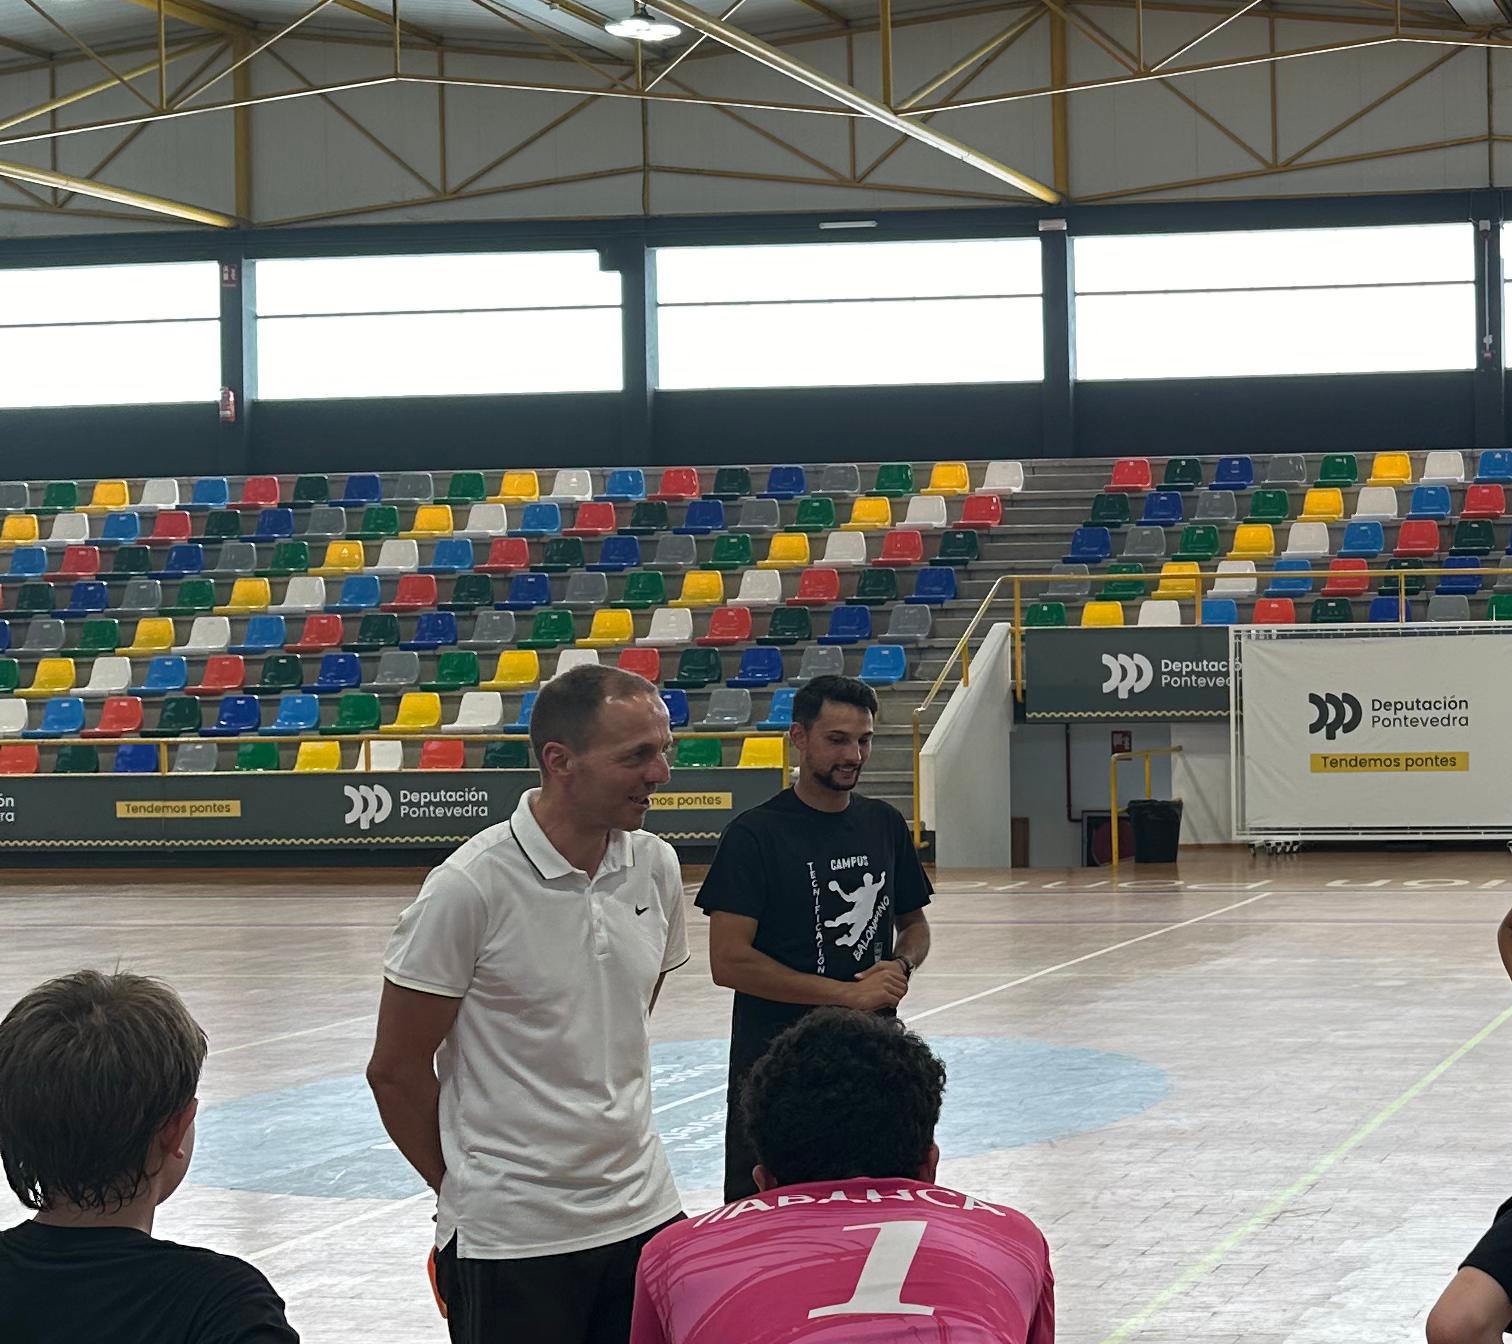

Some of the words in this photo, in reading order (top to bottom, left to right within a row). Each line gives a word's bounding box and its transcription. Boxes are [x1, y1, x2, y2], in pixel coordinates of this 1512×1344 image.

[1161, 657, 1243, 676] Deputacó
[1371, 695, 1469, 715] Deputación
[1371, 714, 1469, 728] Pontevedra
[1321, 756, 1400, 768] Tendemos
[1405, 756, 1457, 771] pontes
[400, 787, 488, 806] Deputación
[678, 795, 722, 808] pontes
[125, 803, 187, 814] Tendemos
[189, 803, 231, 816] pontes
[400, 804, 488, 818] Pontevedra
[830, 855, 869, 871] CAMPUS
[808, 1220, 938, 1320] 1
